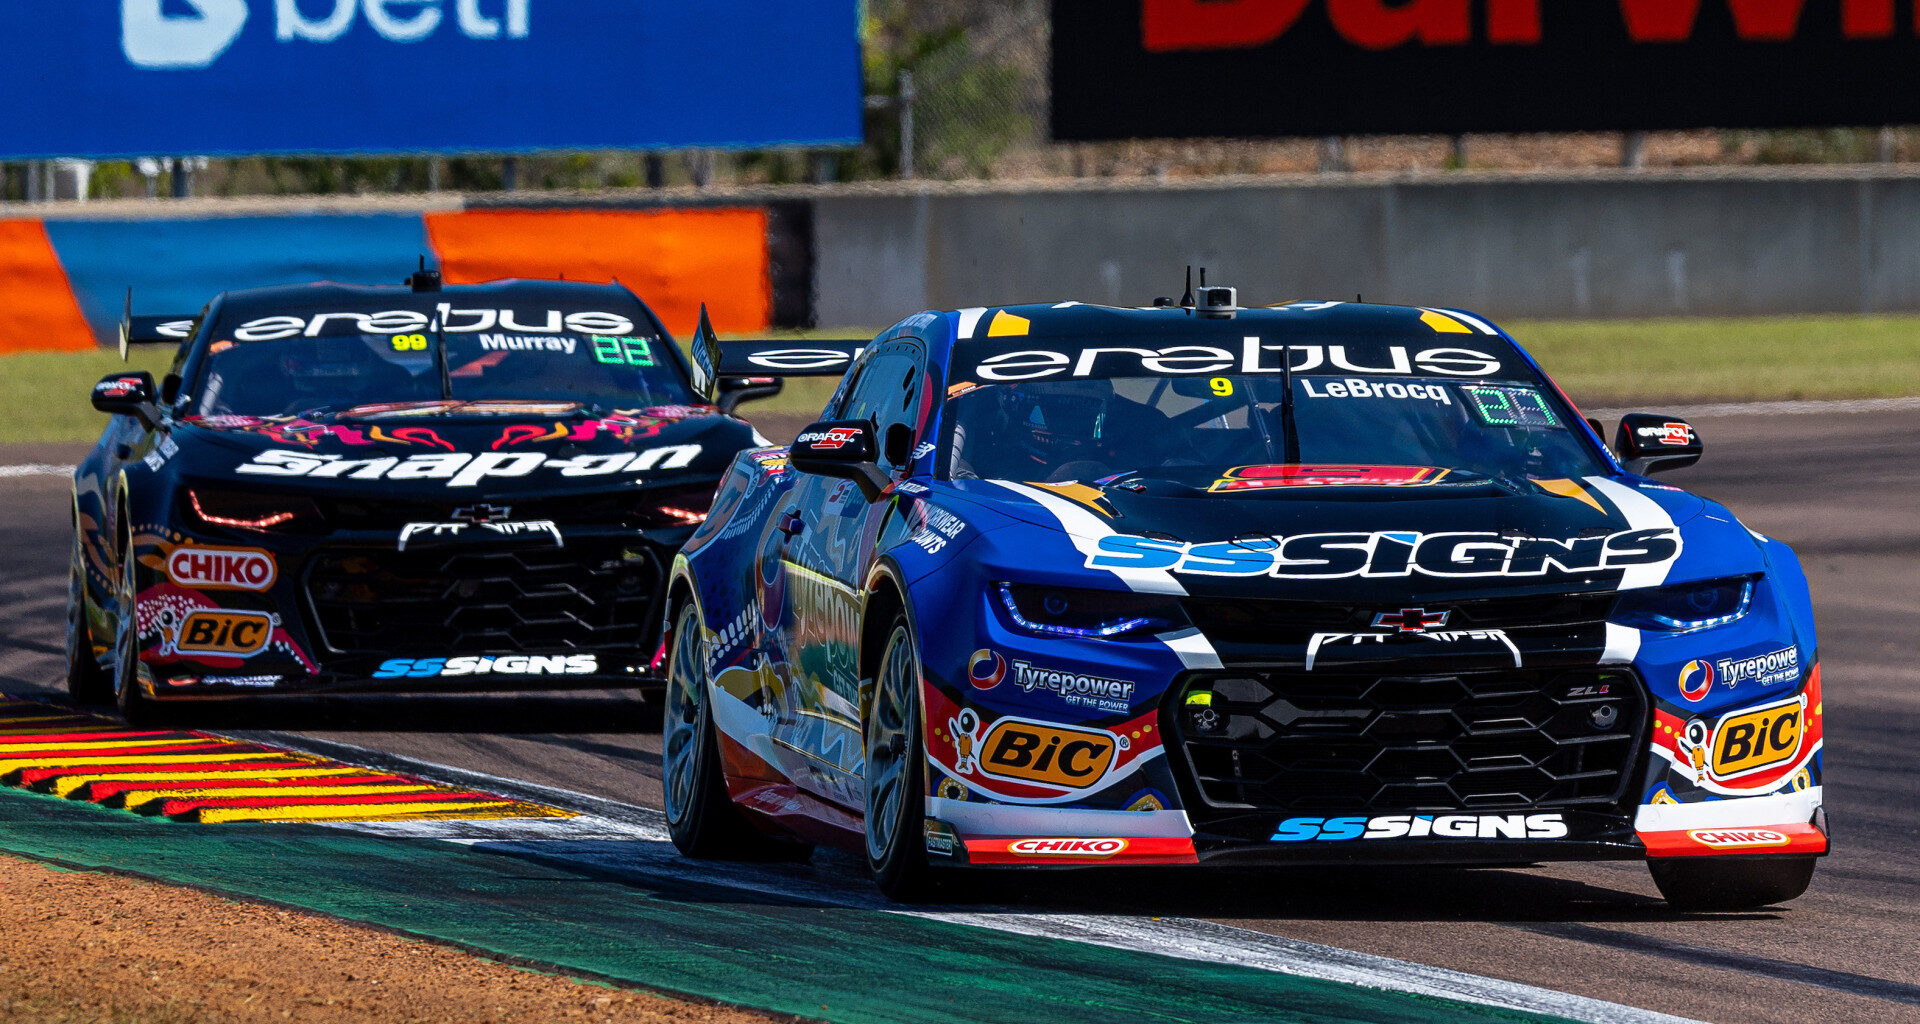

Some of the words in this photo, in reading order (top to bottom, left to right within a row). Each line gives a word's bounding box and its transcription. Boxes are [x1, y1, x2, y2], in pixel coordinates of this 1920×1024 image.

[234, 303, 634, 342] erebus
[391, 334, 428, 351] 99
[478, 333, 577, 355] Murray
[592, 334, 654, 367] 22
[976, 336, 1500, 380] erebus
[1209, 377, 1235, 397] 9
[1301, 377, 1451, 405] LeBrocq
[797, 432, 854, 443] ORAFOL
[172, 553, 269, 584] CHIKO
[1013, 660, 1134, 700] Tyrepower
[1567, 684, 1610, 697] ZL1
[1065, 695, 1081, 705] GET
[1082, 696, 1097, 707] THE
[1098, 699, 1129, 711] POWER
[1016, 839, 1121, 853] CHIKO
[1698, 830, 1782, 845] CHIKO
